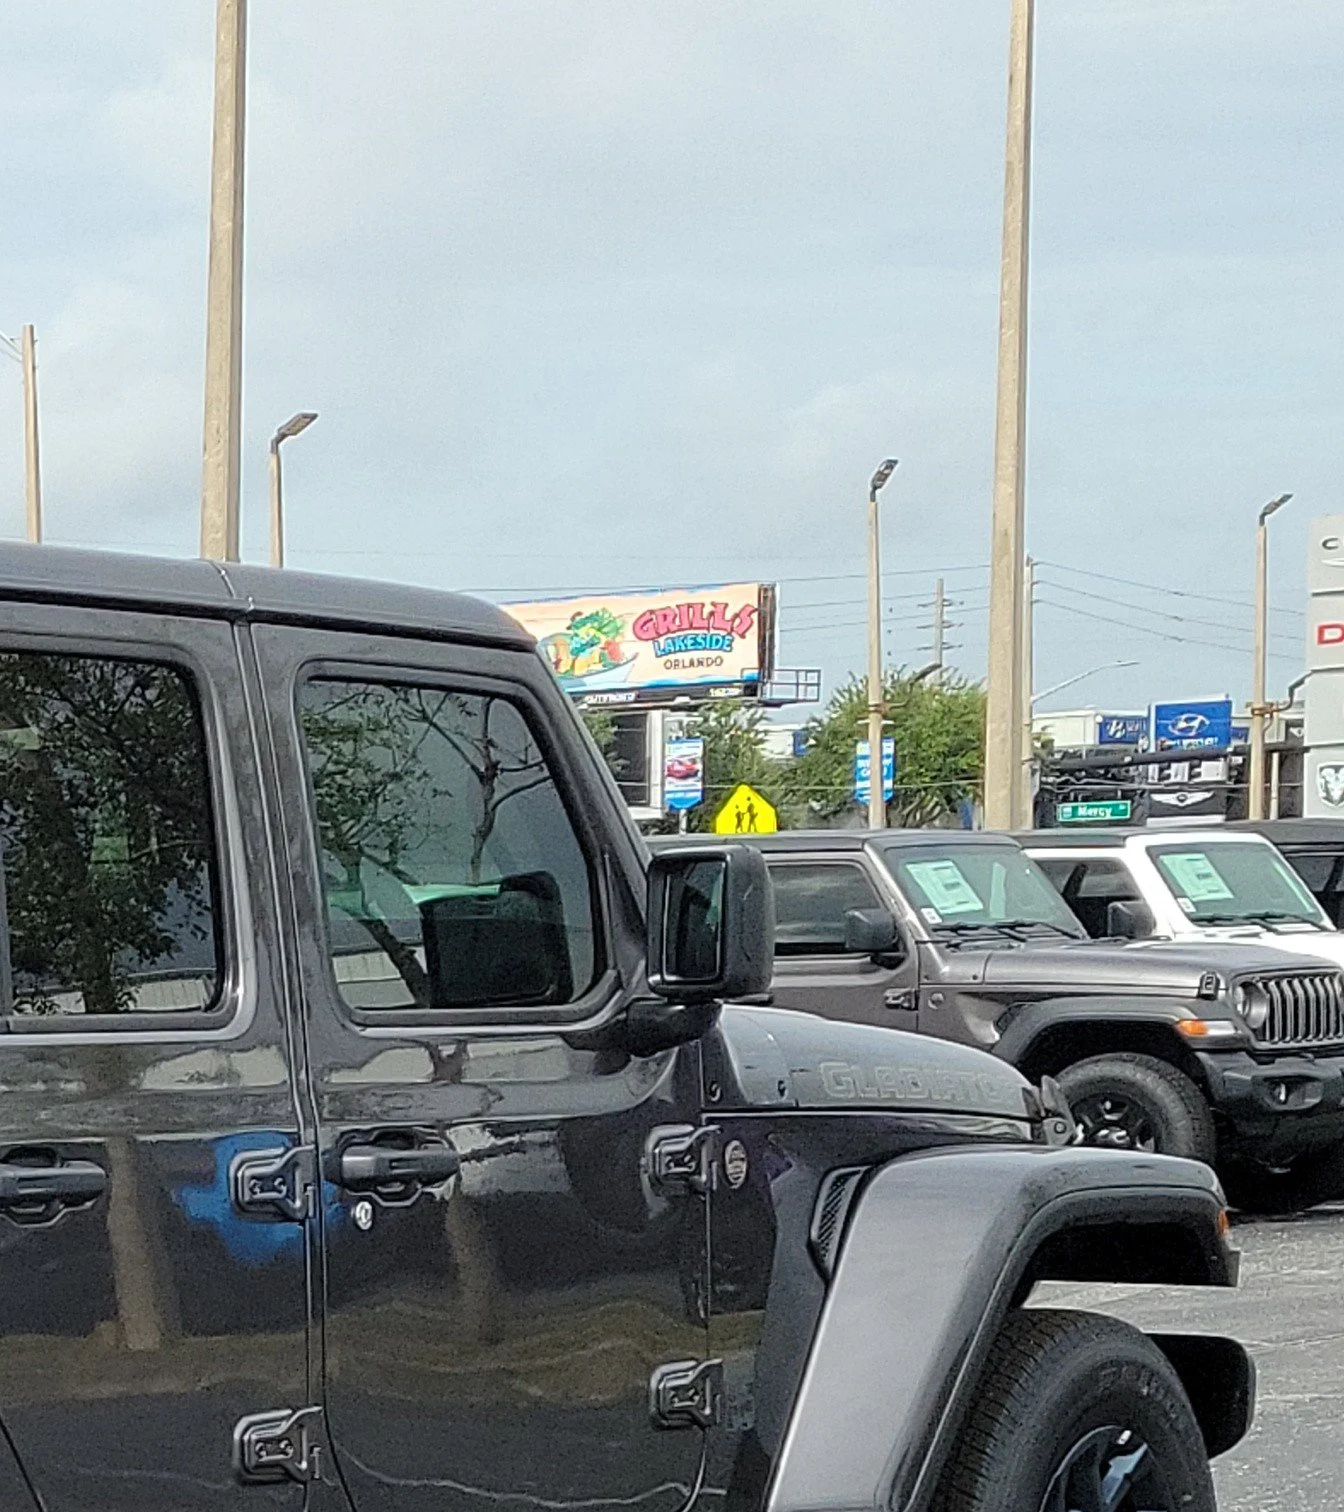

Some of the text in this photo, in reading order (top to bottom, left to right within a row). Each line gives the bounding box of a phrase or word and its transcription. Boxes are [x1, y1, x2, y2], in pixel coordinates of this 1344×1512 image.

[632, 601, 759, 642] GRILLS
[653, 633, 734, 658] LAKESIDE
[663, 655, 724, 671] ORLANDO
